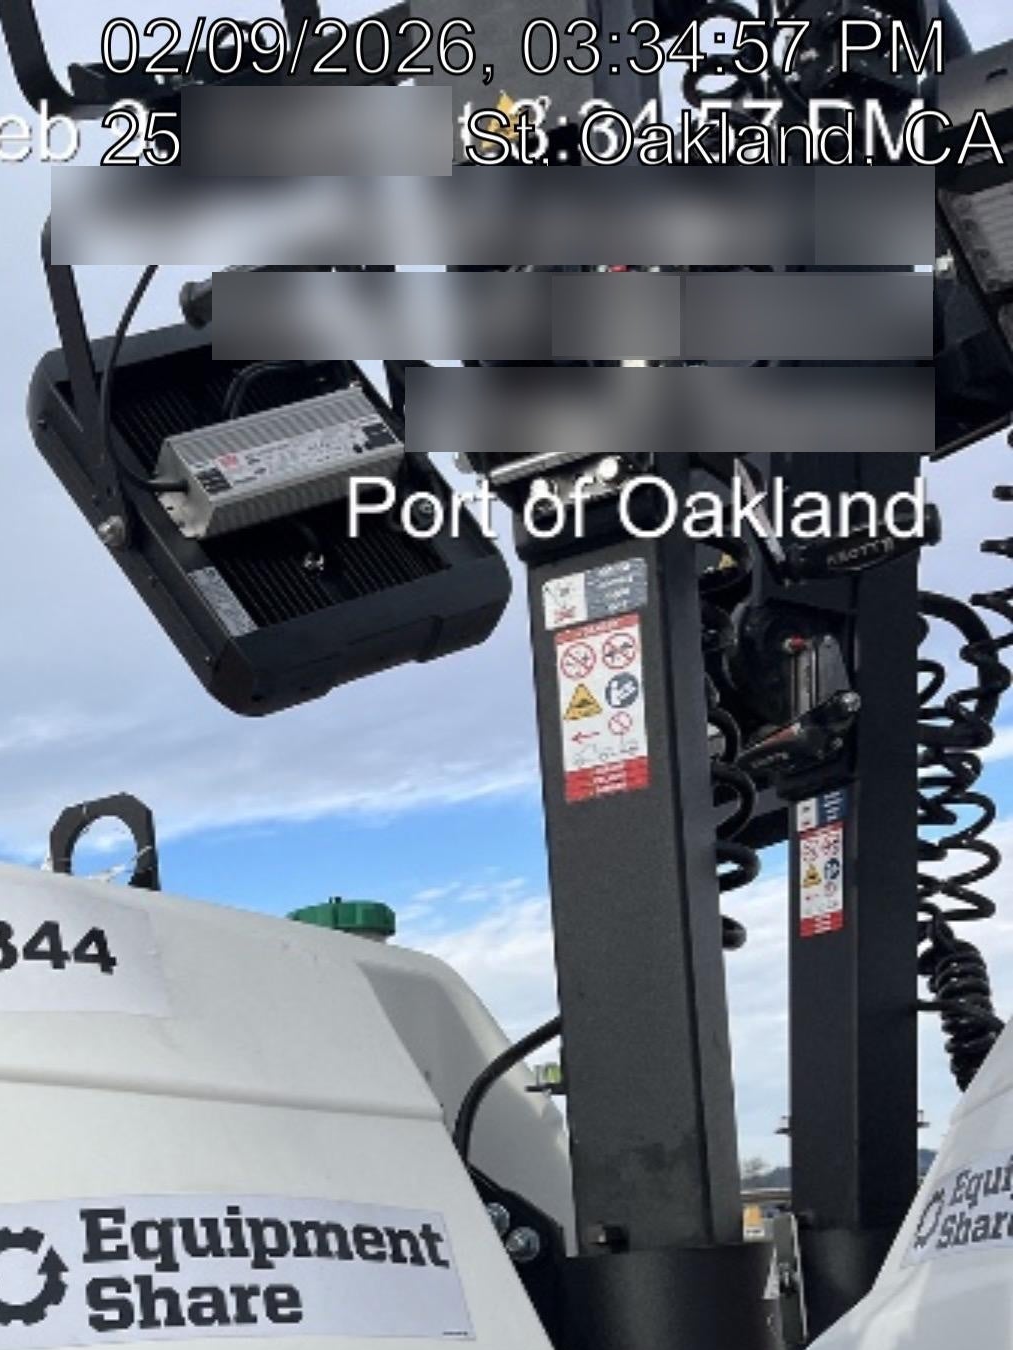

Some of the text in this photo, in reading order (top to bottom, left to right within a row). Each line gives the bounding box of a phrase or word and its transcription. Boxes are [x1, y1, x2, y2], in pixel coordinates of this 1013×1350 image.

[948, 1154, 1013, 1209] Equi
[79, 1205, 451, 1273] Equipment
[85, 1274, 304, 1333] Share
